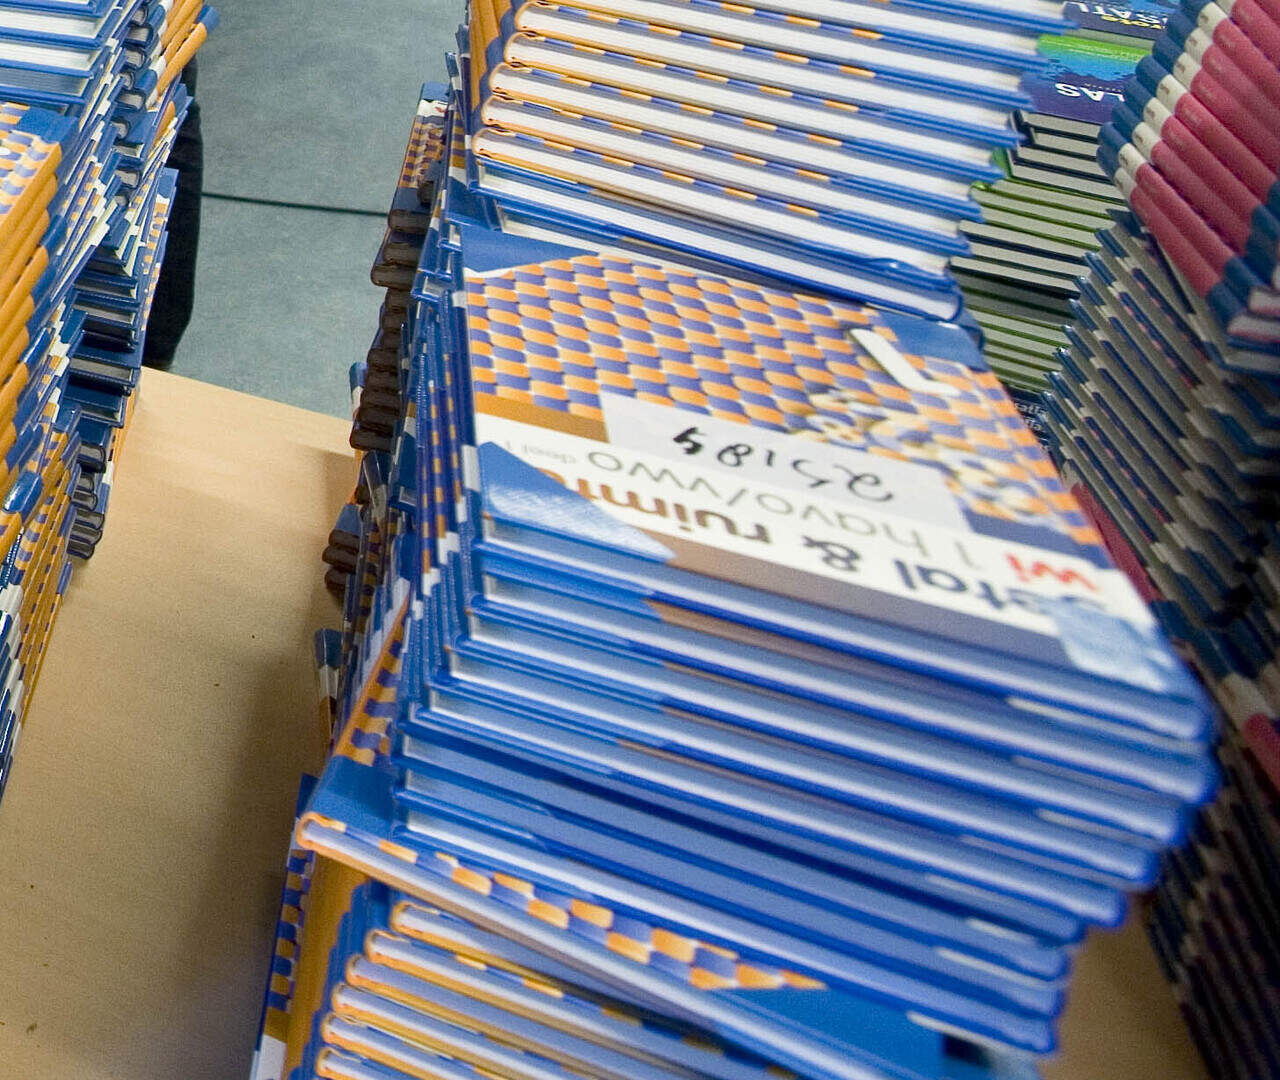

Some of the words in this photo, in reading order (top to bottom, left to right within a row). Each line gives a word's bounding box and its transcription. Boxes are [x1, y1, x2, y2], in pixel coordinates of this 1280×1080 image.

[586, 449, 931, 561] havo/vwo
[802, 533, 861, 574] &
[1005, 551, 1100, 592] wi
[893, 558, 1105, 612] etal
